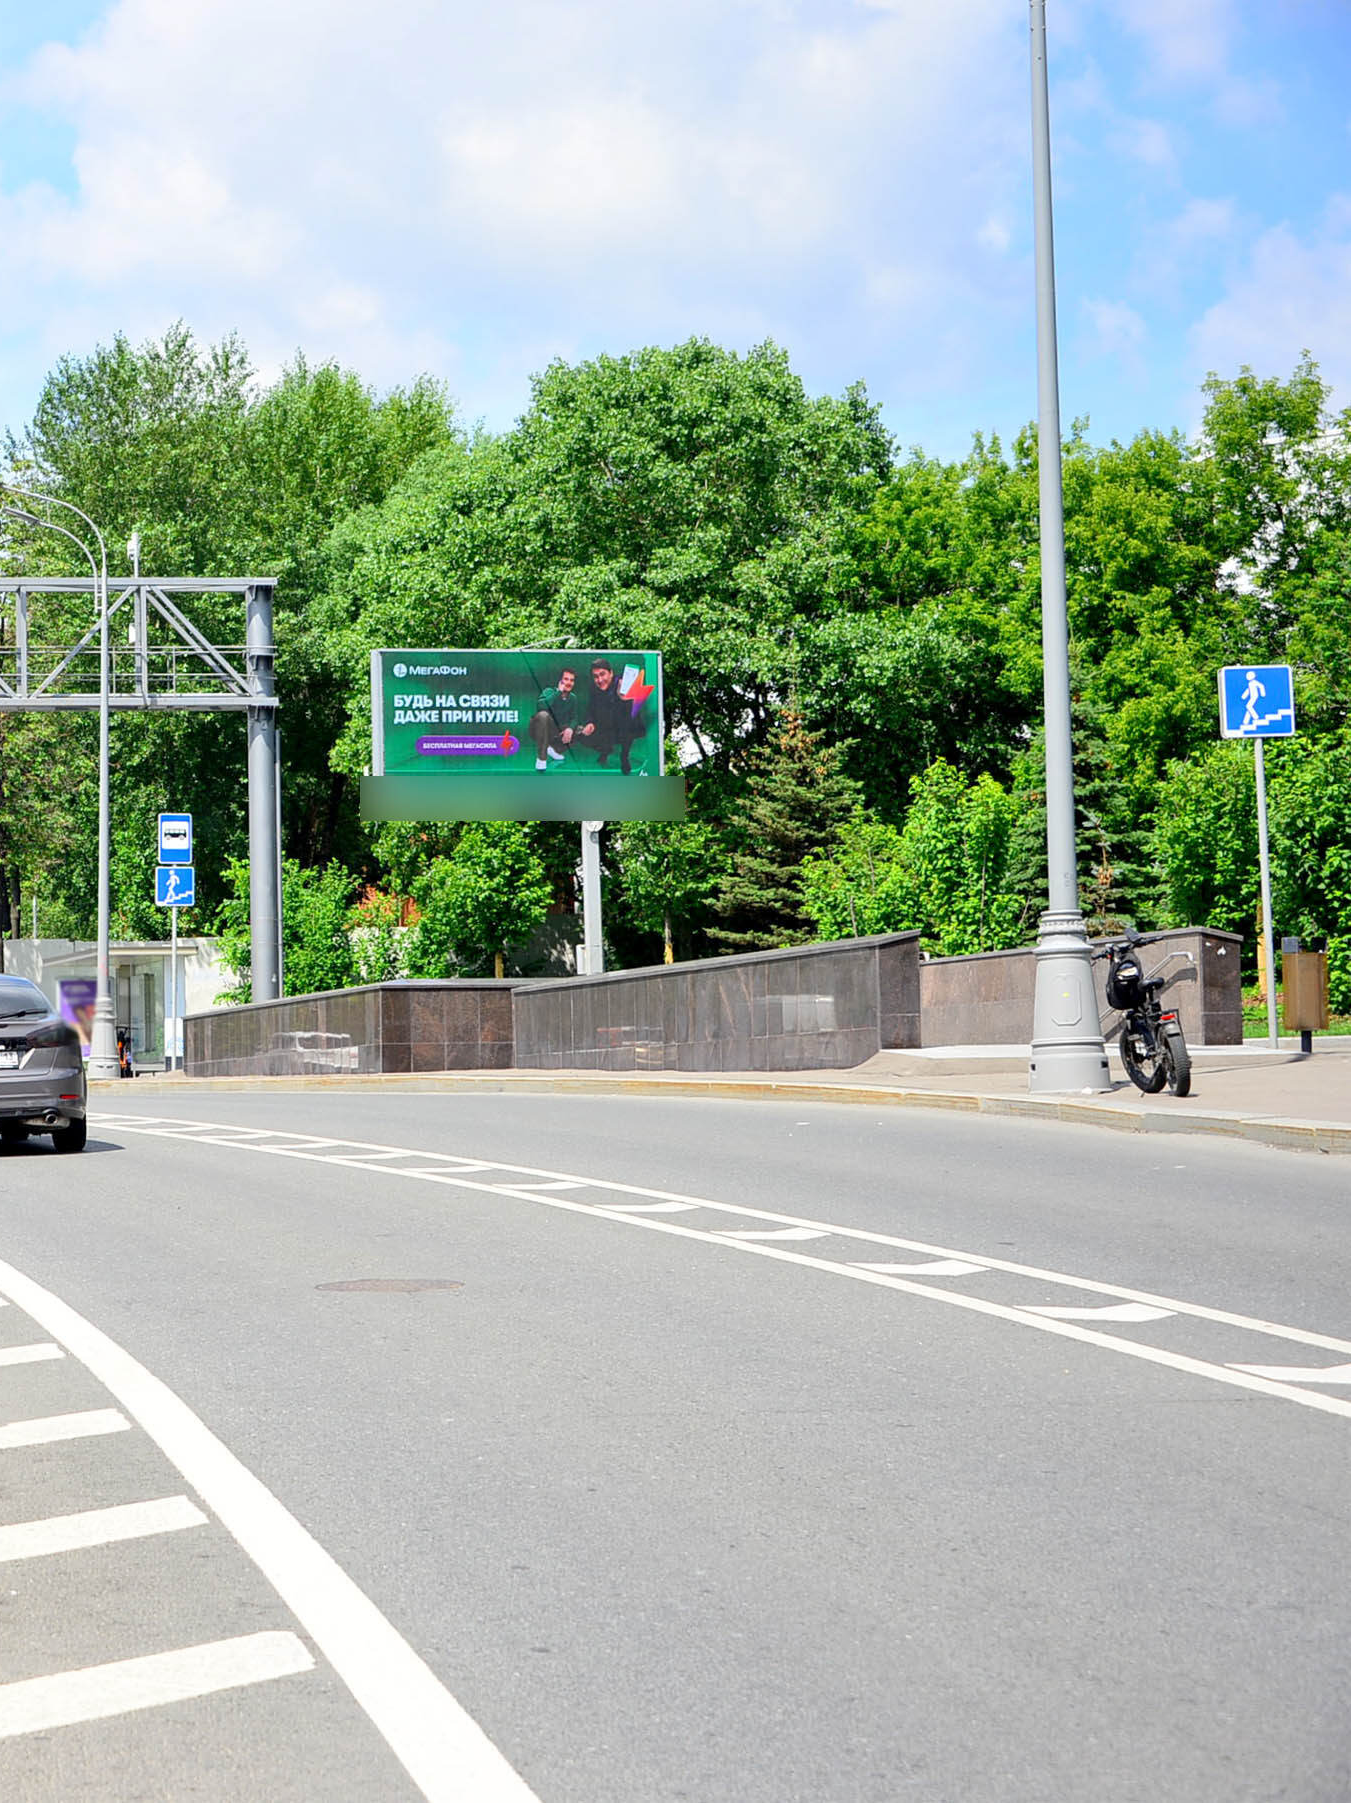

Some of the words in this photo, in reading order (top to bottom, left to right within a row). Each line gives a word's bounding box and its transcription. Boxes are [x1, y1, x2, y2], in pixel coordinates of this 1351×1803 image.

[393, 694, 433, 709] БУДЬ
[435, 694, 457, 708] НА
[458, 694, 510, 708] СВЯЗИ
[393, 710, 439, 725] ДАЖЕ
[441, 710, 473, 723] ПРИ
[475, 710, 519, 723] НУЛЕ!
